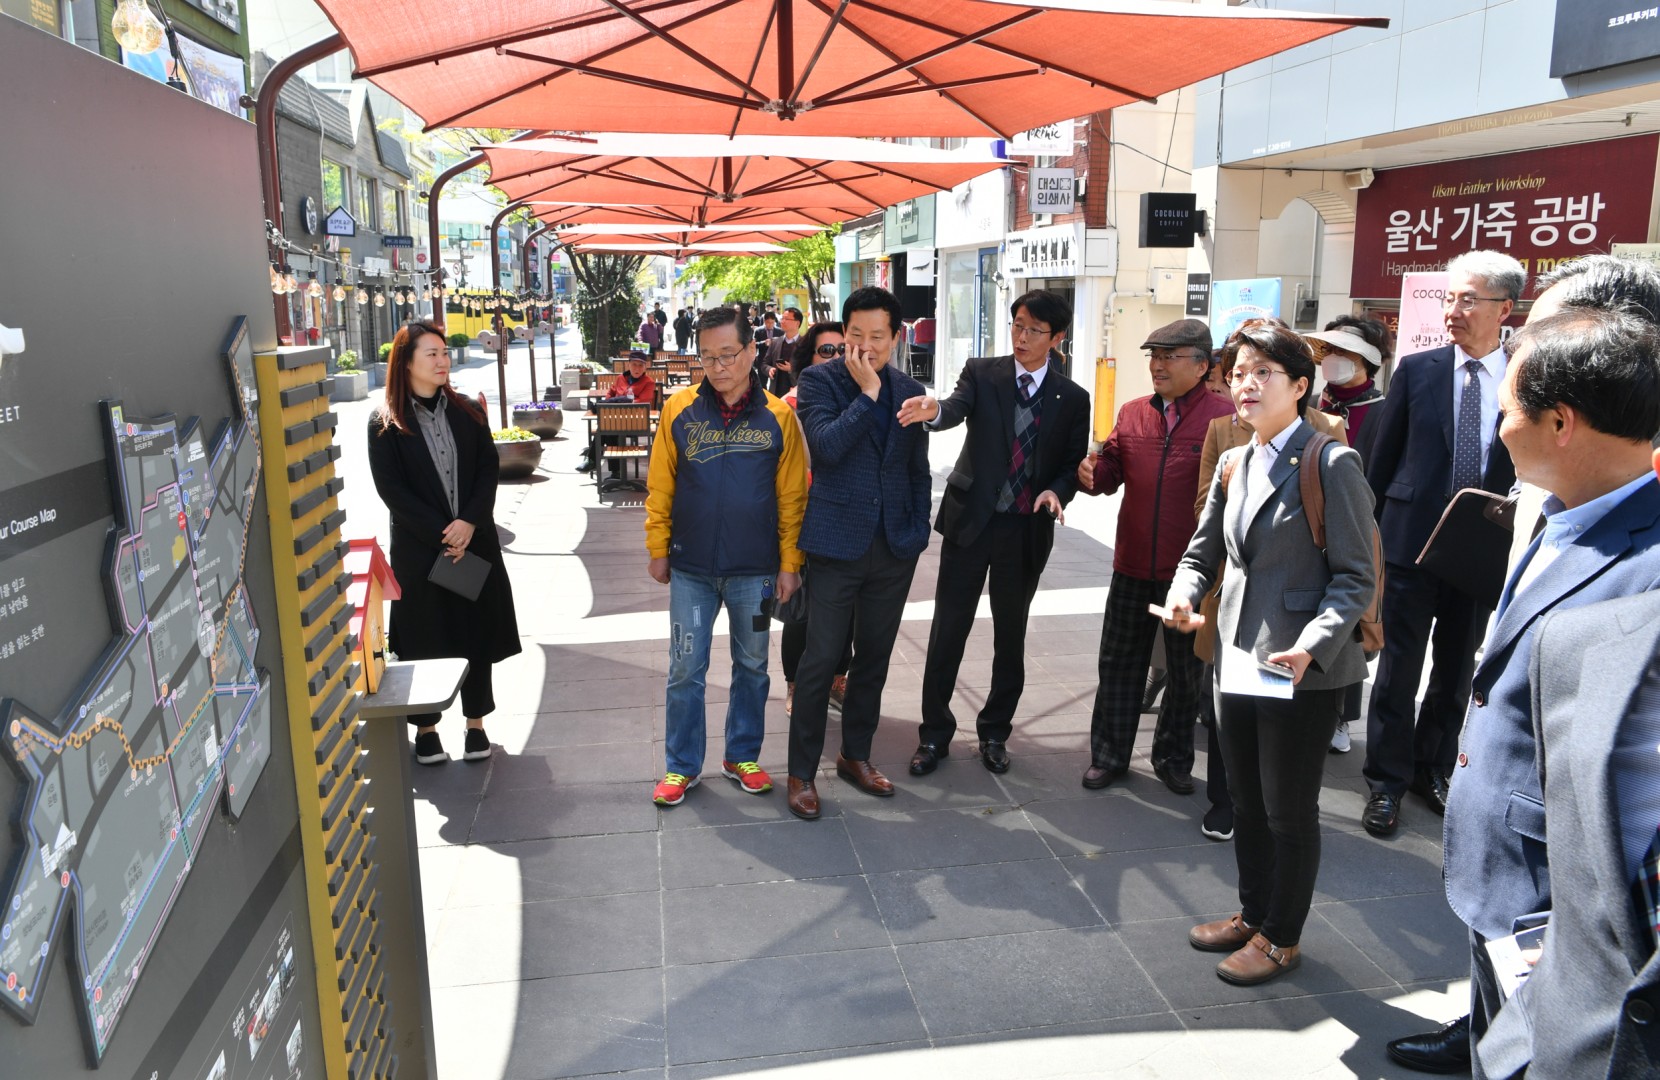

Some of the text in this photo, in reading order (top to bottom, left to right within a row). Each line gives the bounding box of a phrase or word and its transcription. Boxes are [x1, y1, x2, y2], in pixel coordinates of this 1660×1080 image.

[1037, 177, 1059, 190] 대신
[1432, 176, 1546, 198] Ulsan Leather Workshop
[1037, 192, 1070, 205] 인쇄사
[1154, 209, 1189, 218] COCOLULU
[1385, 192, 1605, 253] 울산 가죽 공방
[684, 420, 773, 457] Yankees
[10, 516, 38, 535] Course
[40, 508, 57, 523] Map
[11, 577, 26, 593] 입고
